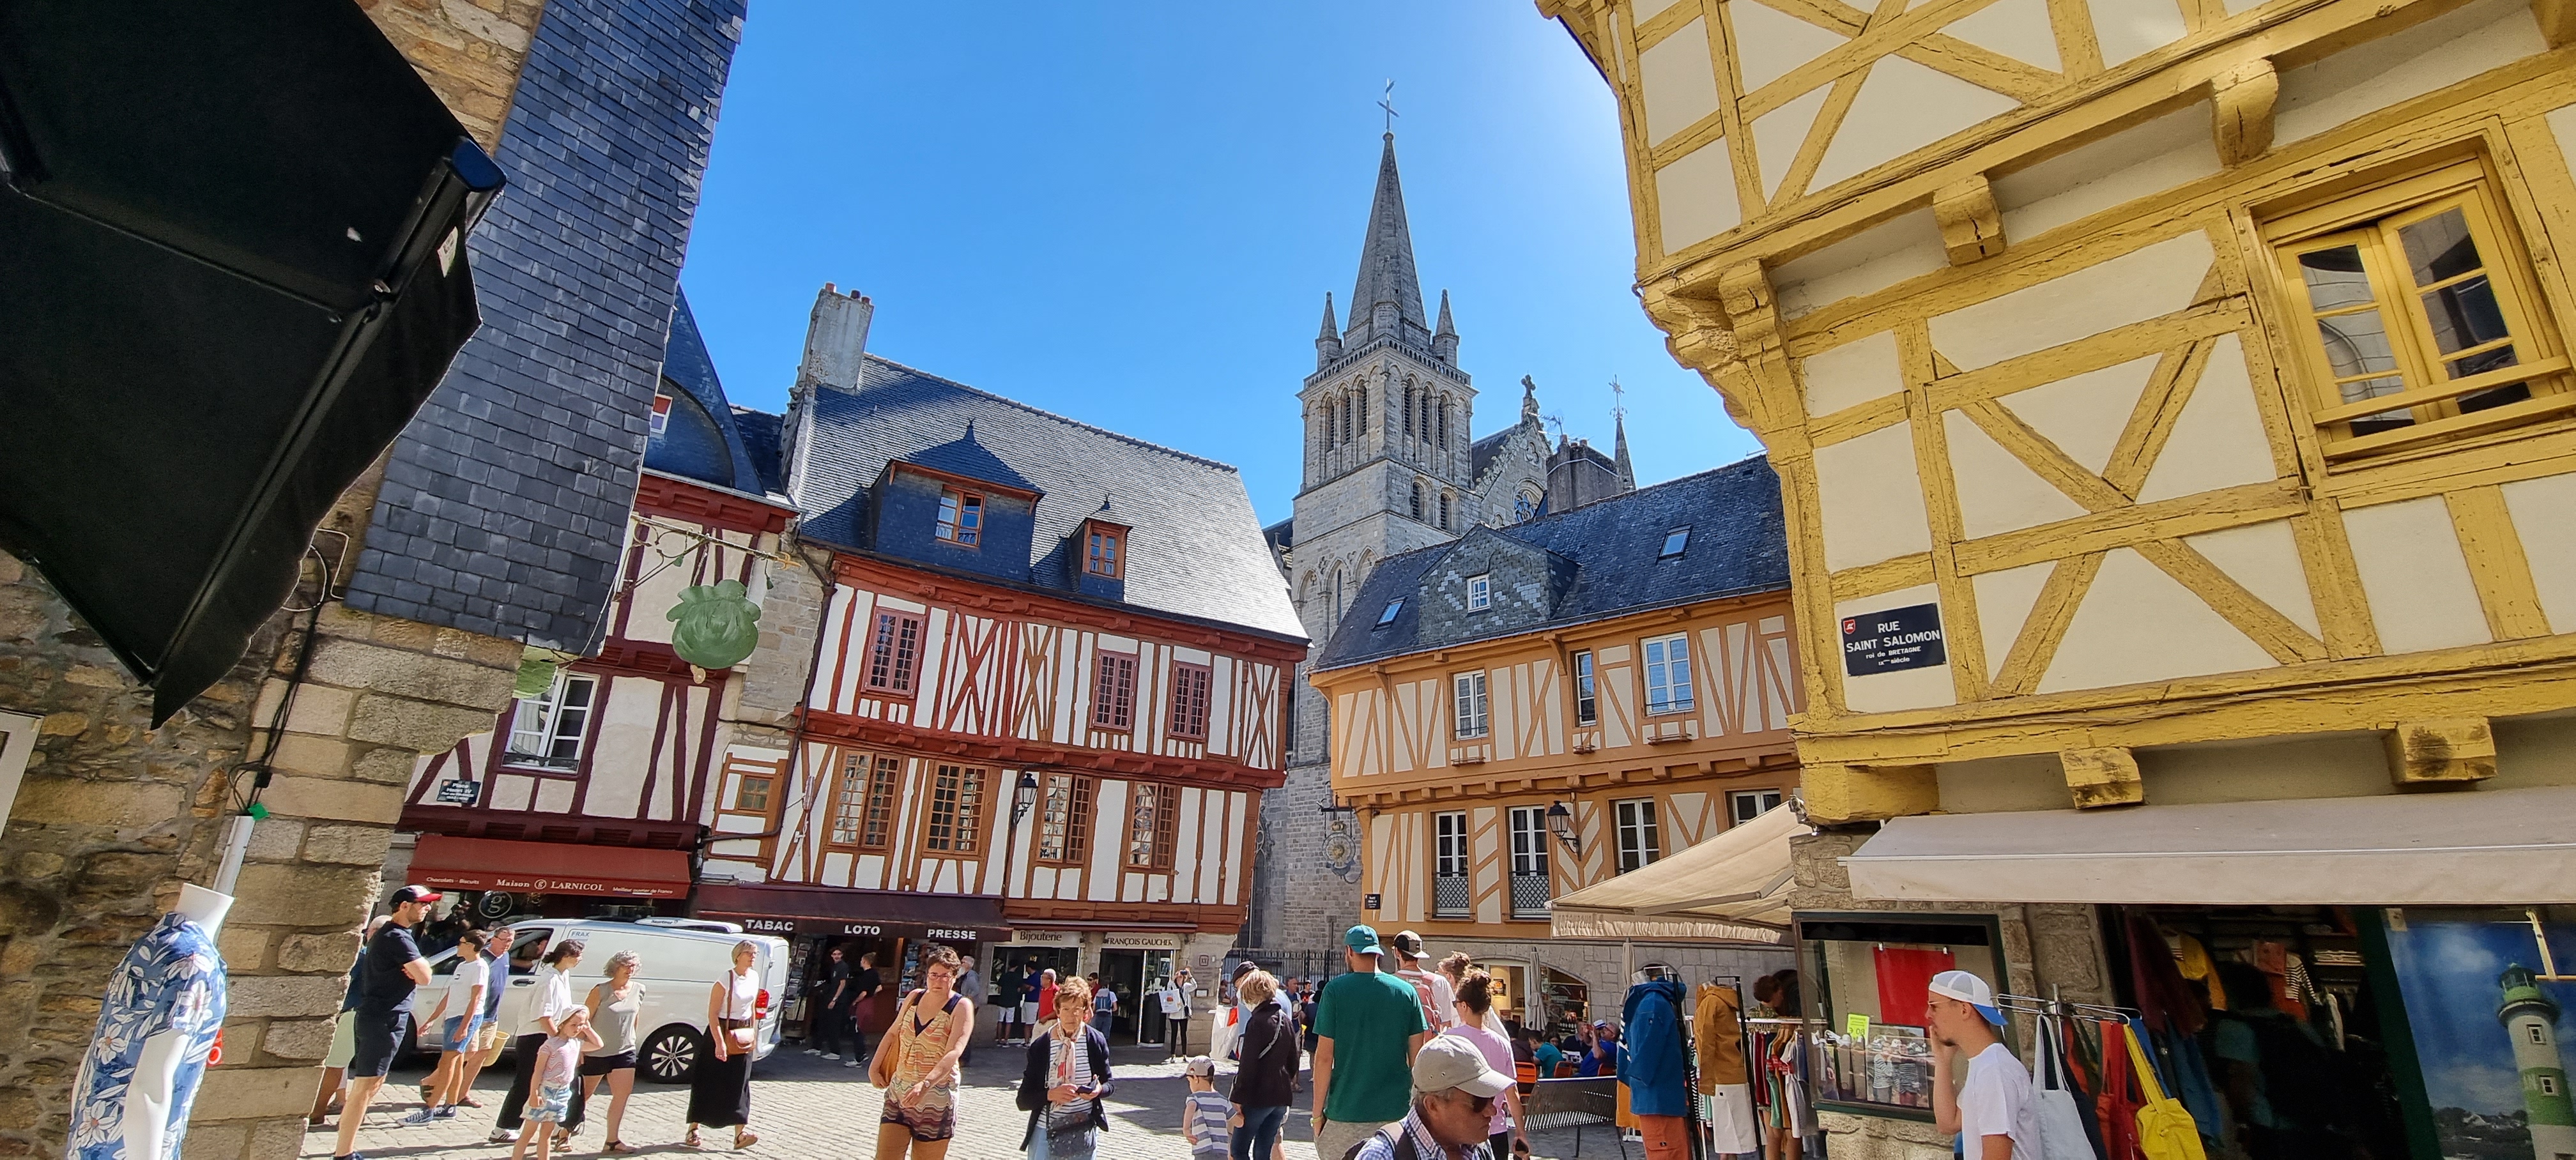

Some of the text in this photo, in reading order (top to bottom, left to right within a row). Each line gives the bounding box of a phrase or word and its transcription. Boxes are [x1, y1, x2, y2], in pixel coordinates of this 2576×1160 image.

[1877, 621, 1901, 633] RUE
[1846, 629, 1941, 653] SAINT SALOMON
[1888, 646, 1921, 656] BRETAGNE
[496, 878, 530, 888] Maison
[550, 881, 604, 891] LARNICOL
[745, 919, 795, 931] TABAC
[844, 924, 880, 935] LOTO
[927, 929, 977, 940] PRESSE
[1020, 931, 1062, 943] Bijouterie
[1107, 937, 1140, 946] FRANÇOIS
